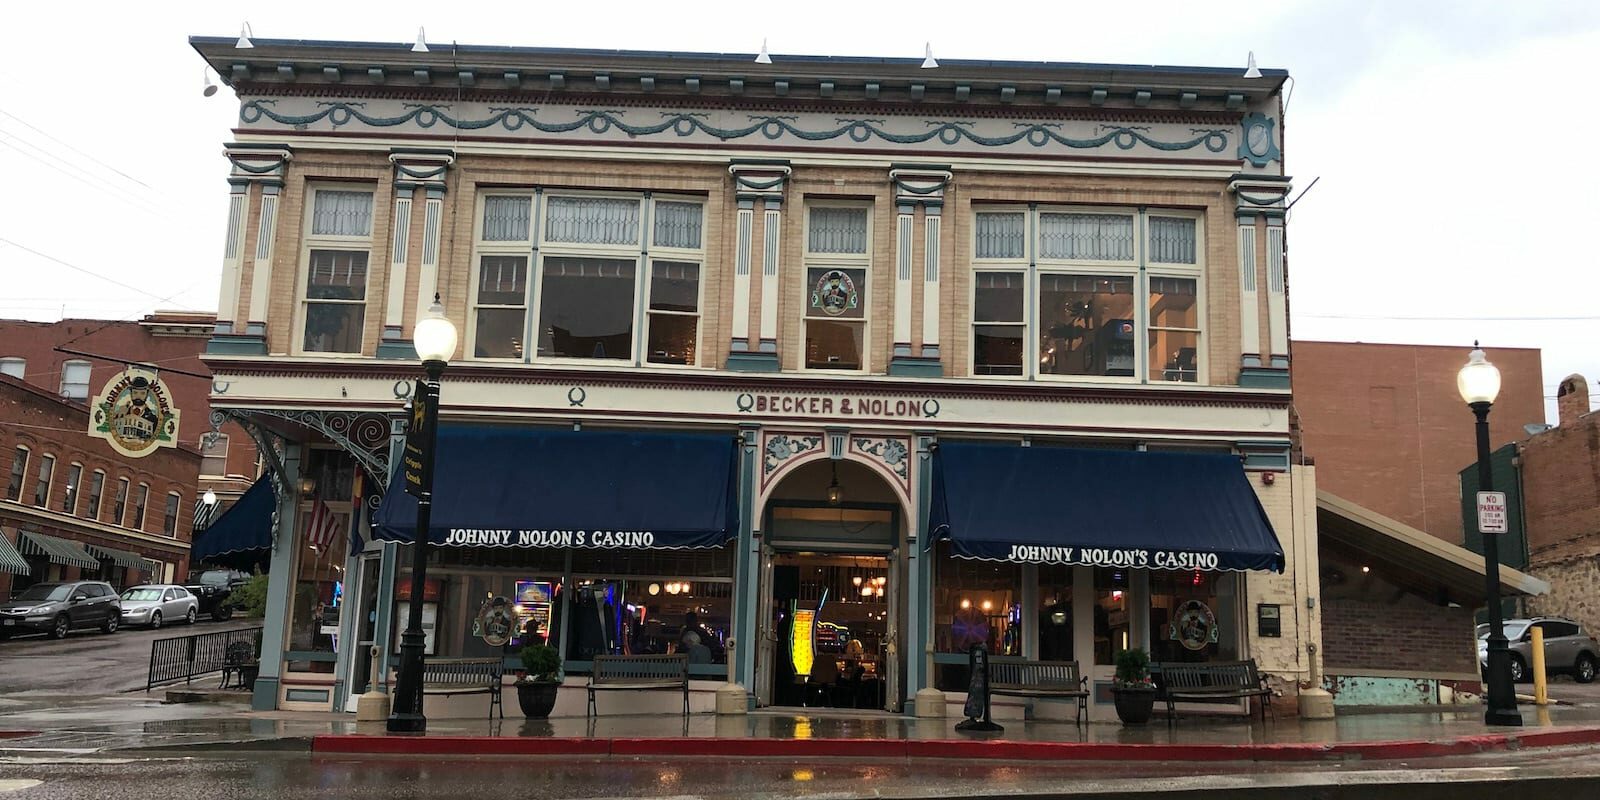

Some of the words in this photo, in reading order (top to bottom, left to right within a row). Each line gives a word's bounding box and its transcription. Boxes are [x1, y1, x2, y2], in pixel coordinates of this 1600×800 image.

[105, 376, 133, 408] JOHNNY
[756, 396, 833, 414] BECKER
[840, 398, 853, 414] &
[858, 399, 920, 417] NOLON
[1480, 504, 1504, 512] PARKING
[1486, 495, 1497, 503] NO
[445, 528, 512, 545] JOHNNY
[591, 531, 654, 547] CASINO
[1008, 544, 1073, 562] JOHNNY
[1080, 548, 1149, 566] NOLON'S
[1154, 551, 1218, 569] CASINO
